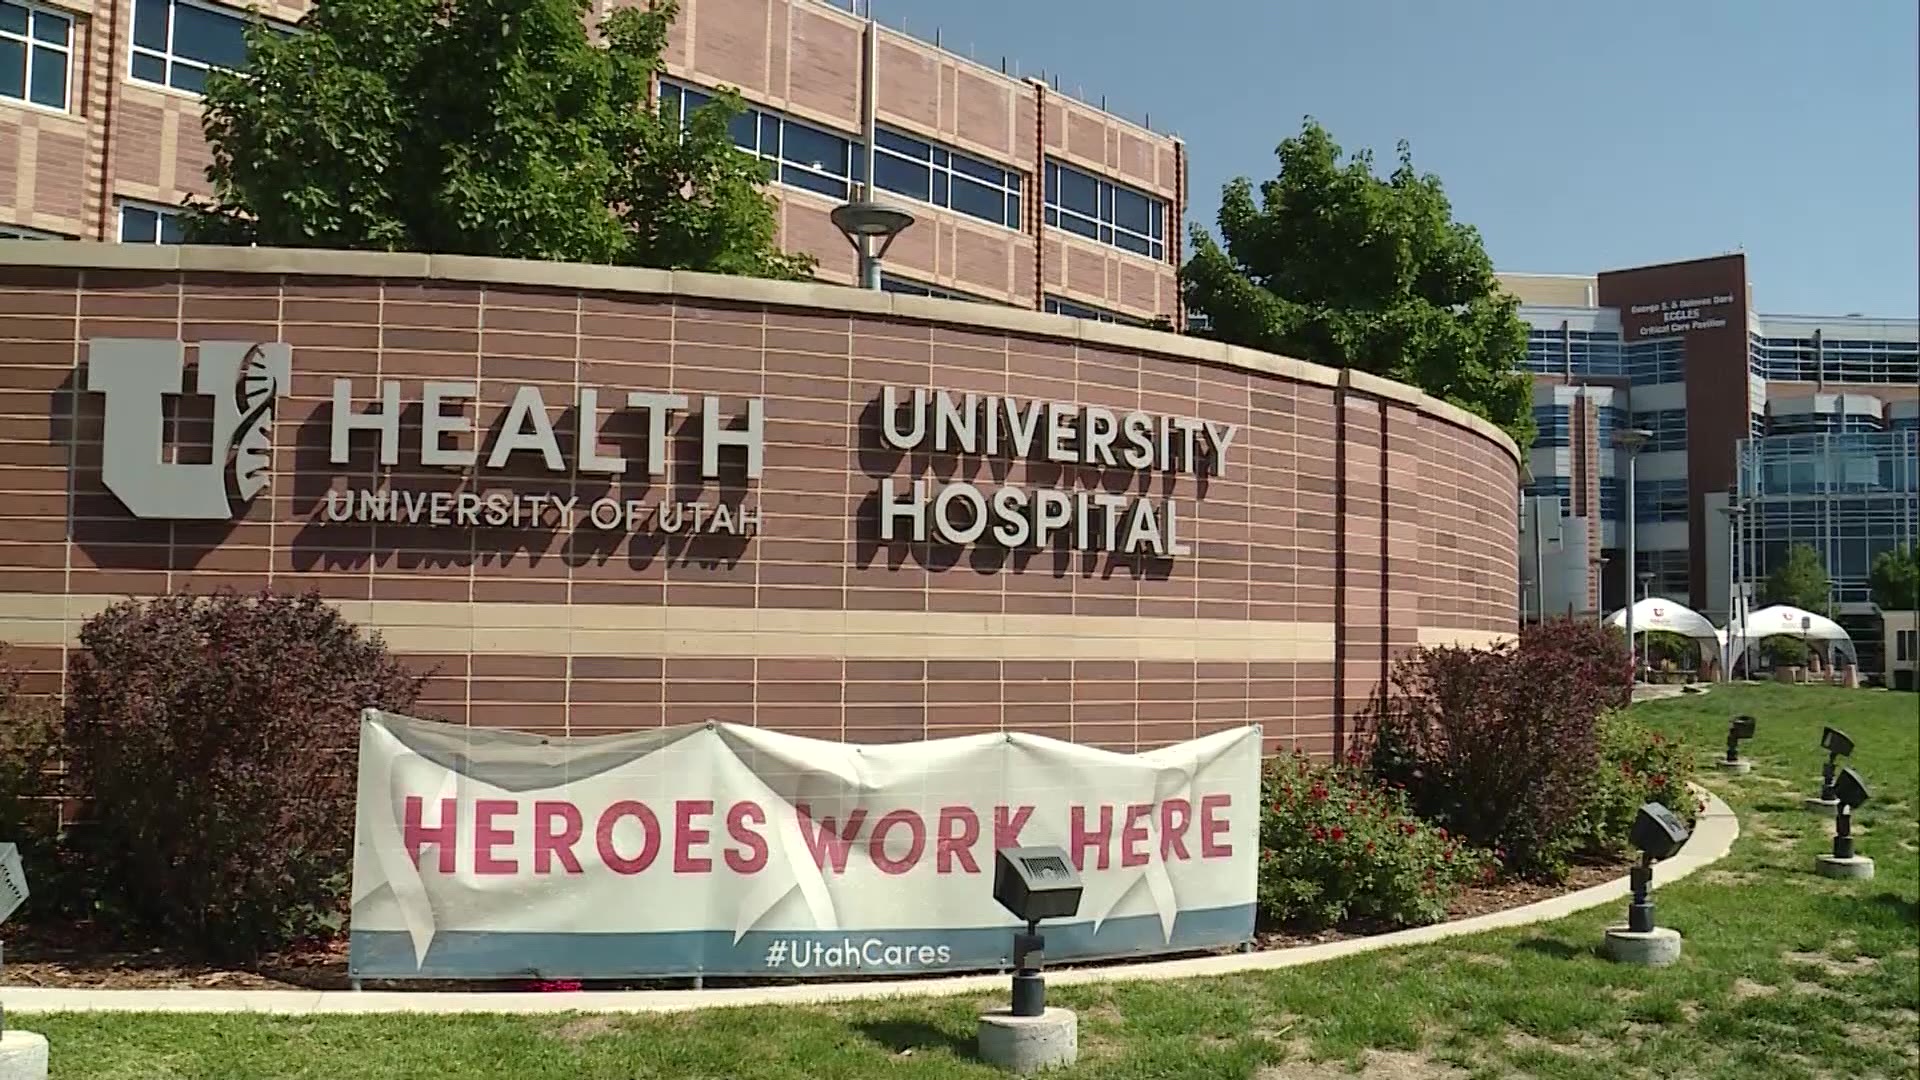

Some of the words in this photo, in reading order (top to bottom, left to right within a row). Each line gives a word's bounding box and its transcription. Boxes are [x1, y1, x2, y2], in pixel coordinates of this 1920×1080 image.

[1663, 308, 1700, 322] ECCLES
[87, 338, 292, 519] U
[330, 378, 763, 479] HEALTH
[882, 385, 1238, 476] UNIVERSITY
[327, 489, 578, 527] UNIVERSITY
[590, 498, 645, 531] OF
[658, 501, 762, 535] UTAH
[880, 478, 1191, 556] HOSPITAL
[404, 796, 769, 875] HEROES
[796, 804, 1036, 874] WORK
[1070, 794, 1233, 871] HERE
[765, 938, 951, 969] #UtahCares
